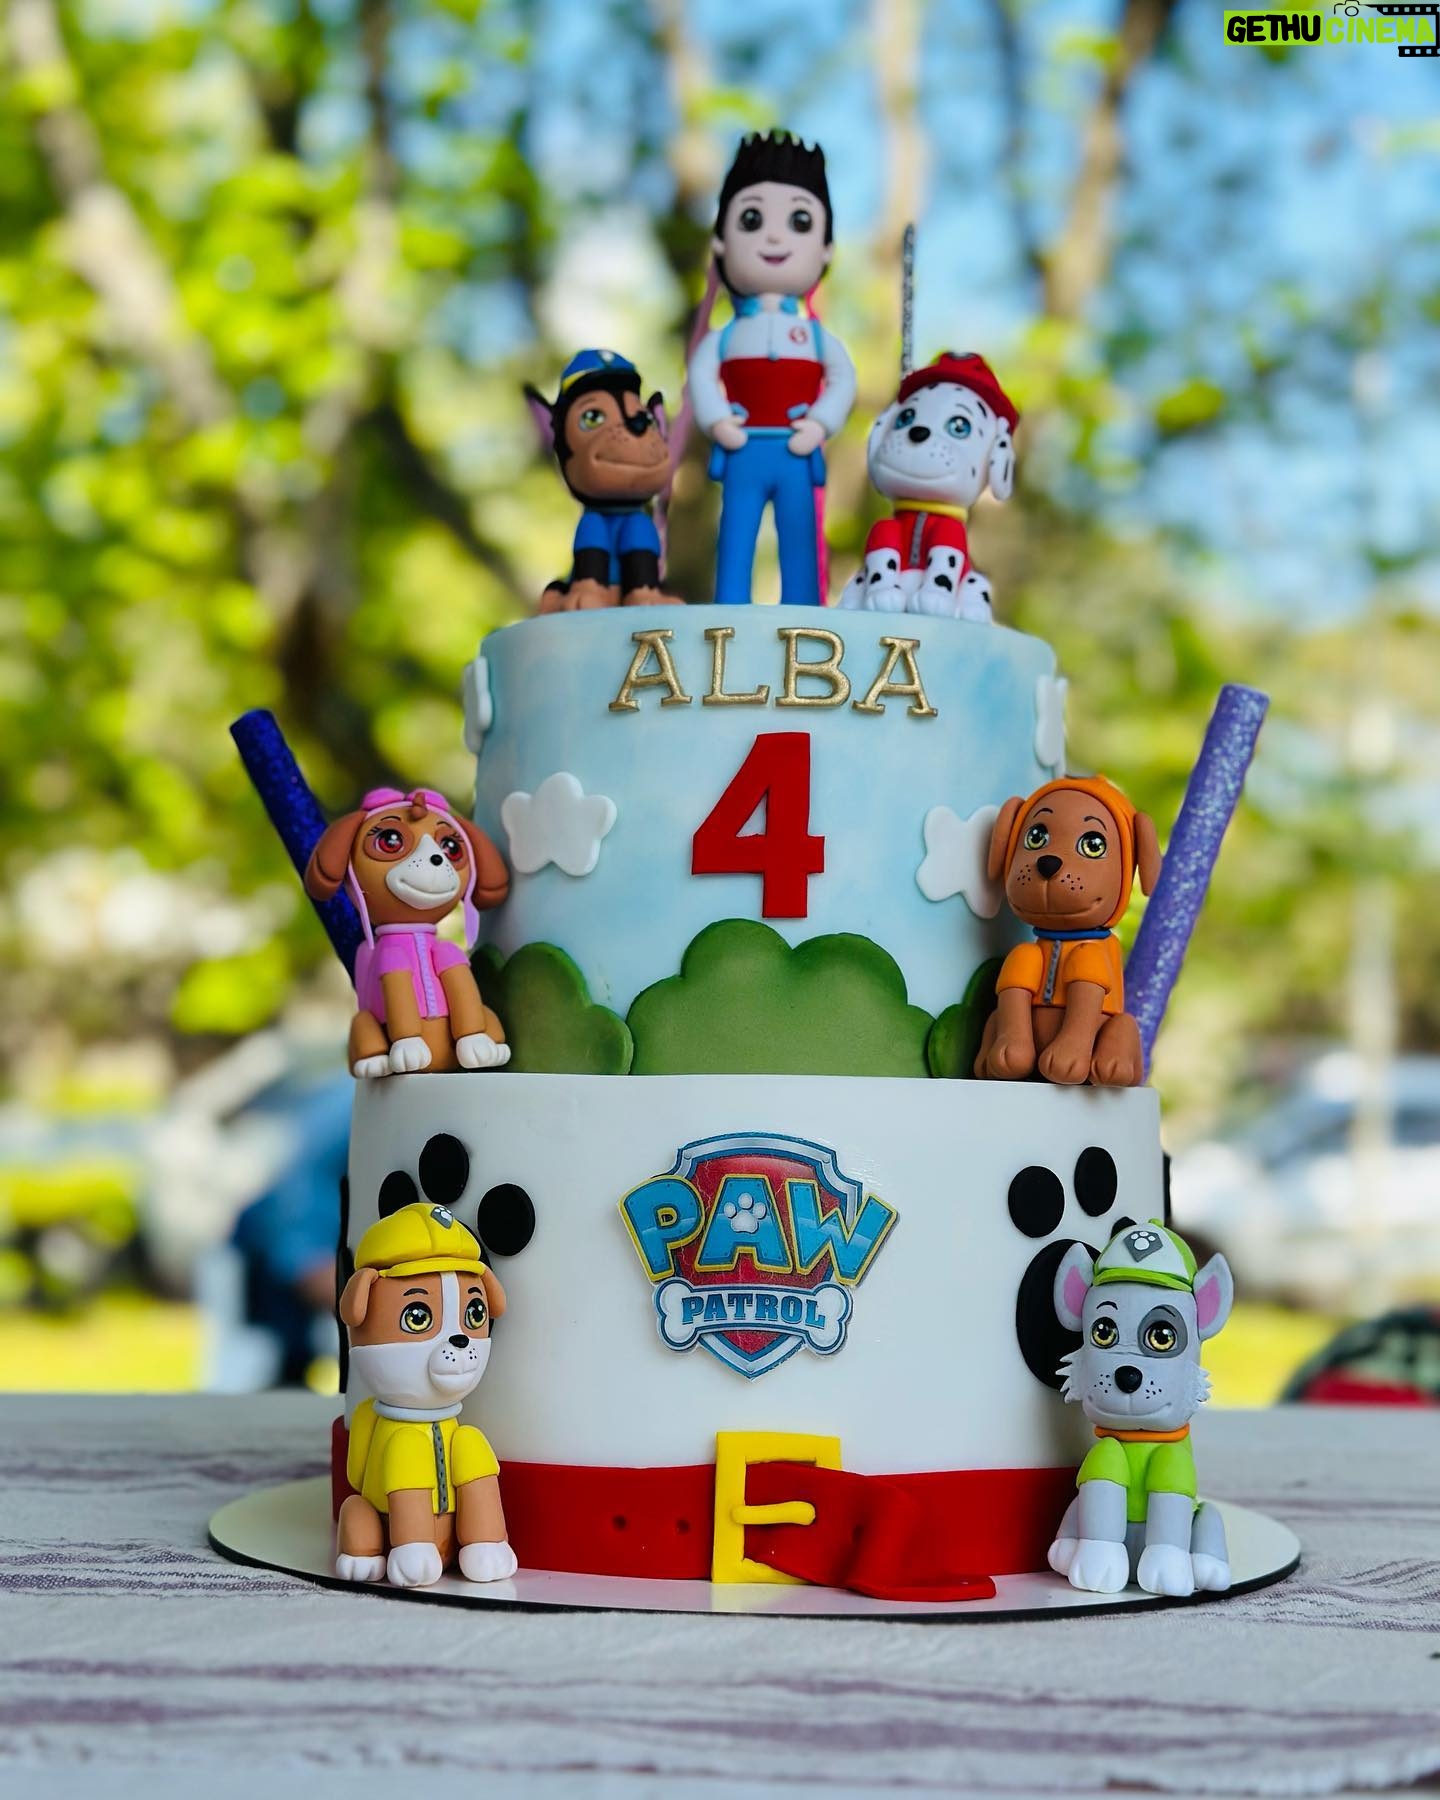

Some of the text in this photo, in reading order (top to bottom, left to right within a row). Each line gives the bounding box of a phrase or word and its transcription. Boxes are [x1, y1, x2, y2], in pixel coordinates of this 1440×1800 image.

[608, 627, 938, 718] ALBA
[691, 731, 825, 918] 4
[618, 1173, 898, 1286] PAW
[682, 1293, 826, 1330] PATROL
